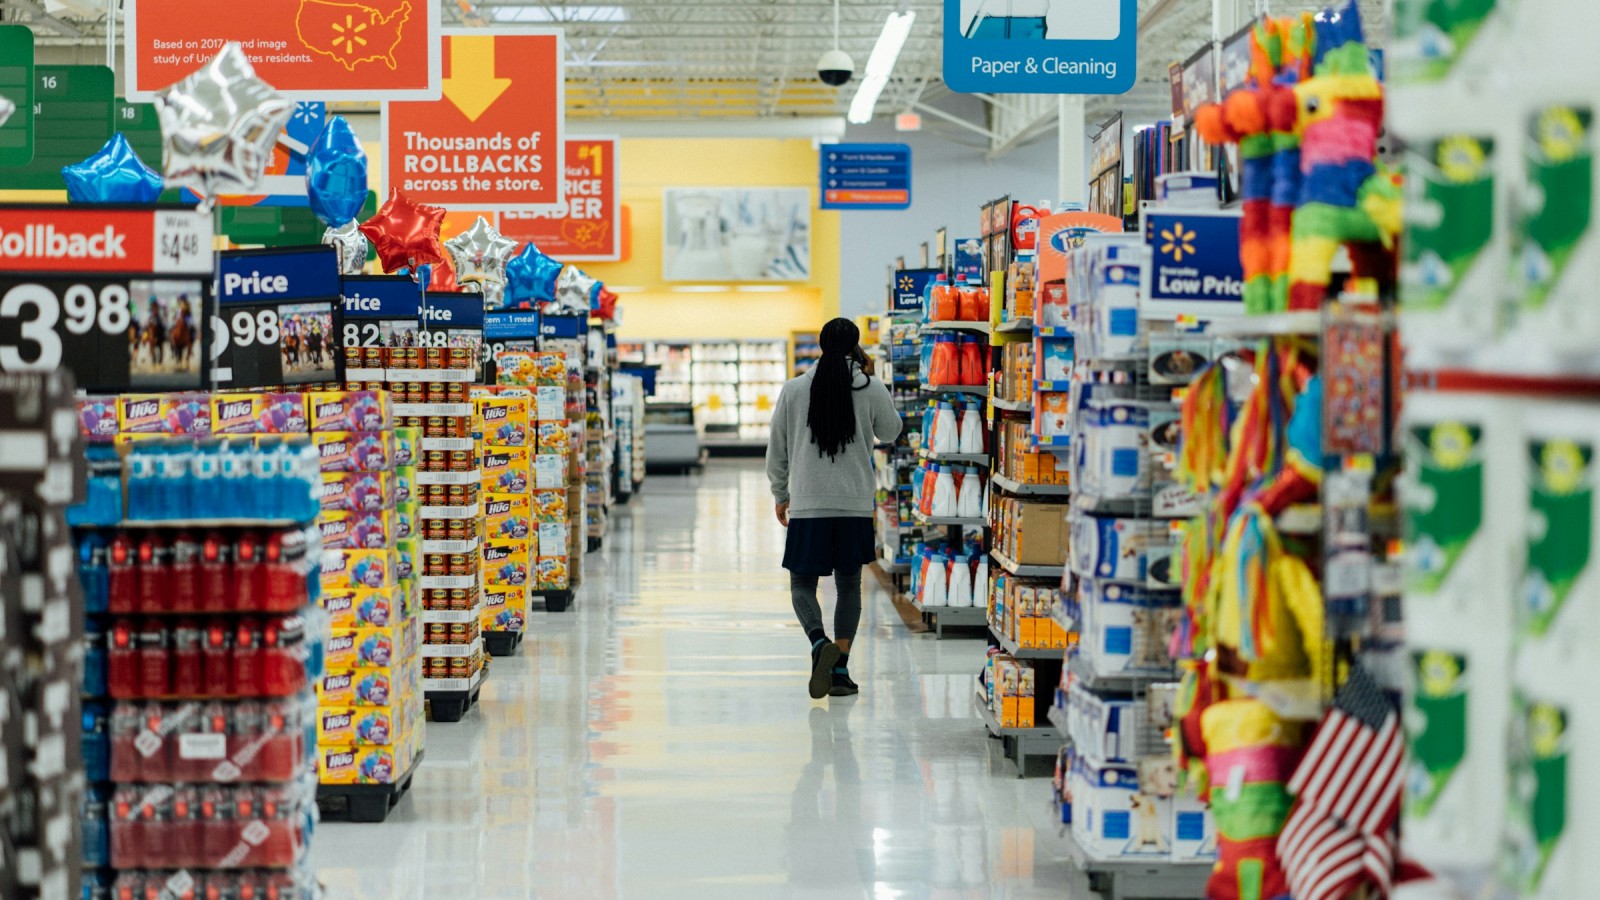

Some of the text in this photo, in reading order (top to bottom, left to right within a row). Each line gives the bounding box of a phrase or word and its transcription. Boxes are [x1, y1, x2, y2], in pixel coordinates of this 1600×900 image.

[153, 39, 183, 49] Based
[185, 40, 198, 49] on
[200, 38, 223, 49] 2017
[257, 38, 287, 51] image
[153, 53, 180, 66] study
[182, 53, 195, 64] of
[265, 53, 313, 63] residents.
[971, 56, 1117, 79] Paper & Cleaning
[41, 76, 57, 89] 16
[121, 107, 135, 119] 18
[403, 131, 541, 151] Thousands of
[404, 154, 543, 174] ROLLBACKS
[403, 175, 544, 192] across the store.
[0, 224, 126, 258] ollback
[224, 271, 289, 296] Price
[1159, 275, 1201, 294] Low
[900, 297, 917, 305] Low
[514, 315, 535, 323] meal
[343, 323, 380, 347] 82
[130, 401, 158, 419] HUG
[223, 402, 252, 419] HUG
[320, 403, 343, 418] HUG
[485, 408, 507, 420] HUG
[322, 442, 346, 457] HUG
[489, 503, 510, 515] HUG
[323, 522, 346, 536] HUG
[327, 598, 351, 611] HUG
[486, 594, 505, 606] HUG
[329, 638, 353, 652] HUG
[326, 676, 350, 691] HUG
[326, 715, 350, 730] HUG
[329, 754, 353, 768] HUG
